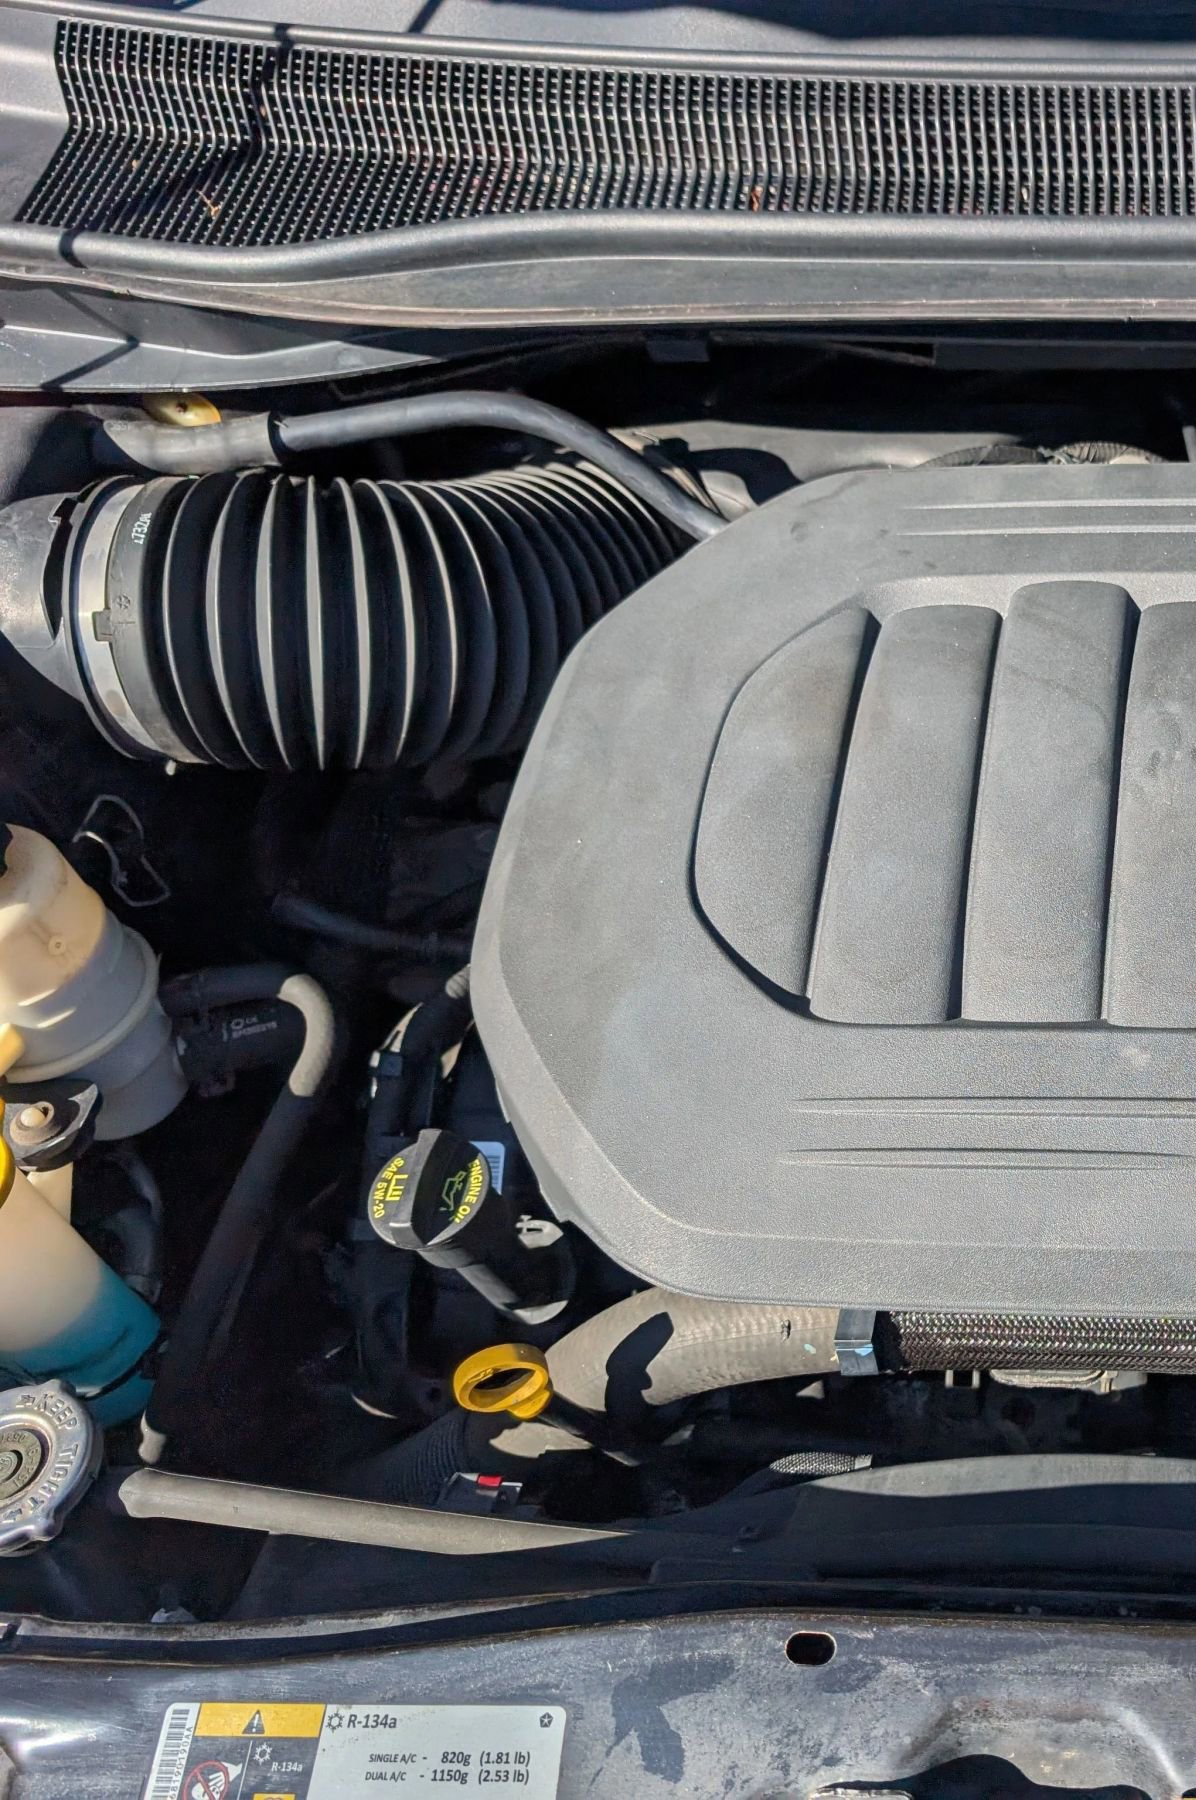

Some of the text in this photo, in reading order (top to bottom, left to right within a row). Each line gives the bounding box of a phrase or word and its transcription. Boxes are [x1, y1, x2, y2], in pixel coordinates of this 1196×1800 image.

[373, 1157, 405, 1218] SAE 5W-20
[465, 1159, 484, 1204] ENGINE
[347, 1714, 398, 1729] R-134a
[271, 1761, 303, 1772] R-134a
[368, 1751, 531, 1767] SINGLE A/C 820g (1.81 lb)
[365, 1769, 530, 1786] DUAL A/C 1150g (2.53 lb)
